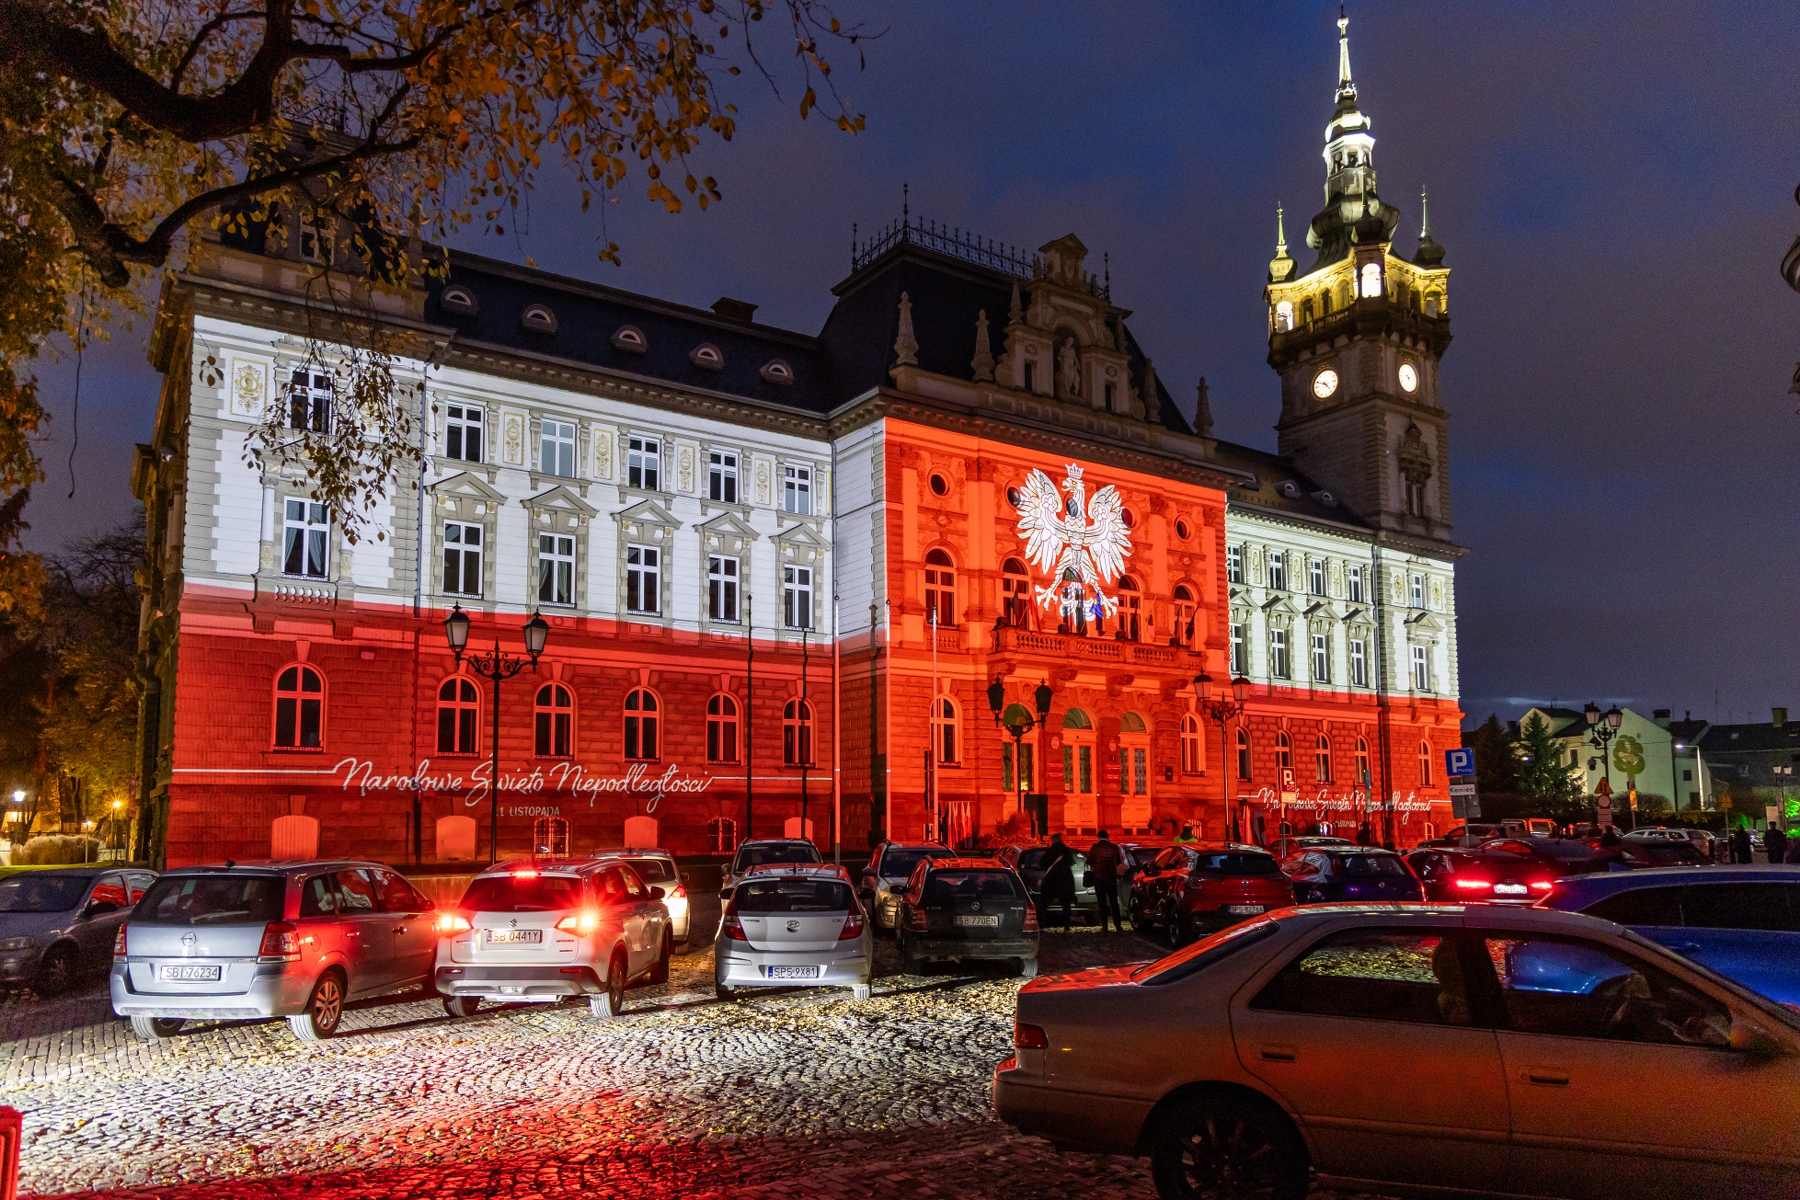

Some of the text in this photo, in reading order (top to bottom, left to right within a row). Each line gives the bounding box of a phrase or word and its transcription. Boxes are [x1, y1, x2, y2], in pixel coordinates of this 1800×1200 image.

[1451, 752, 1467, 773] P
[342, 752, 712, 813] Narodowe Święto Niepodległości
[1283, 769, 1293, 786] P
[509, 806, 560, 817] LISTOPADA
[493, 931, 538, 942] SB 0441Y
[166, 967, 218, 978] SBI 76234
[773, 967, 815, 977] SPS 9X81
